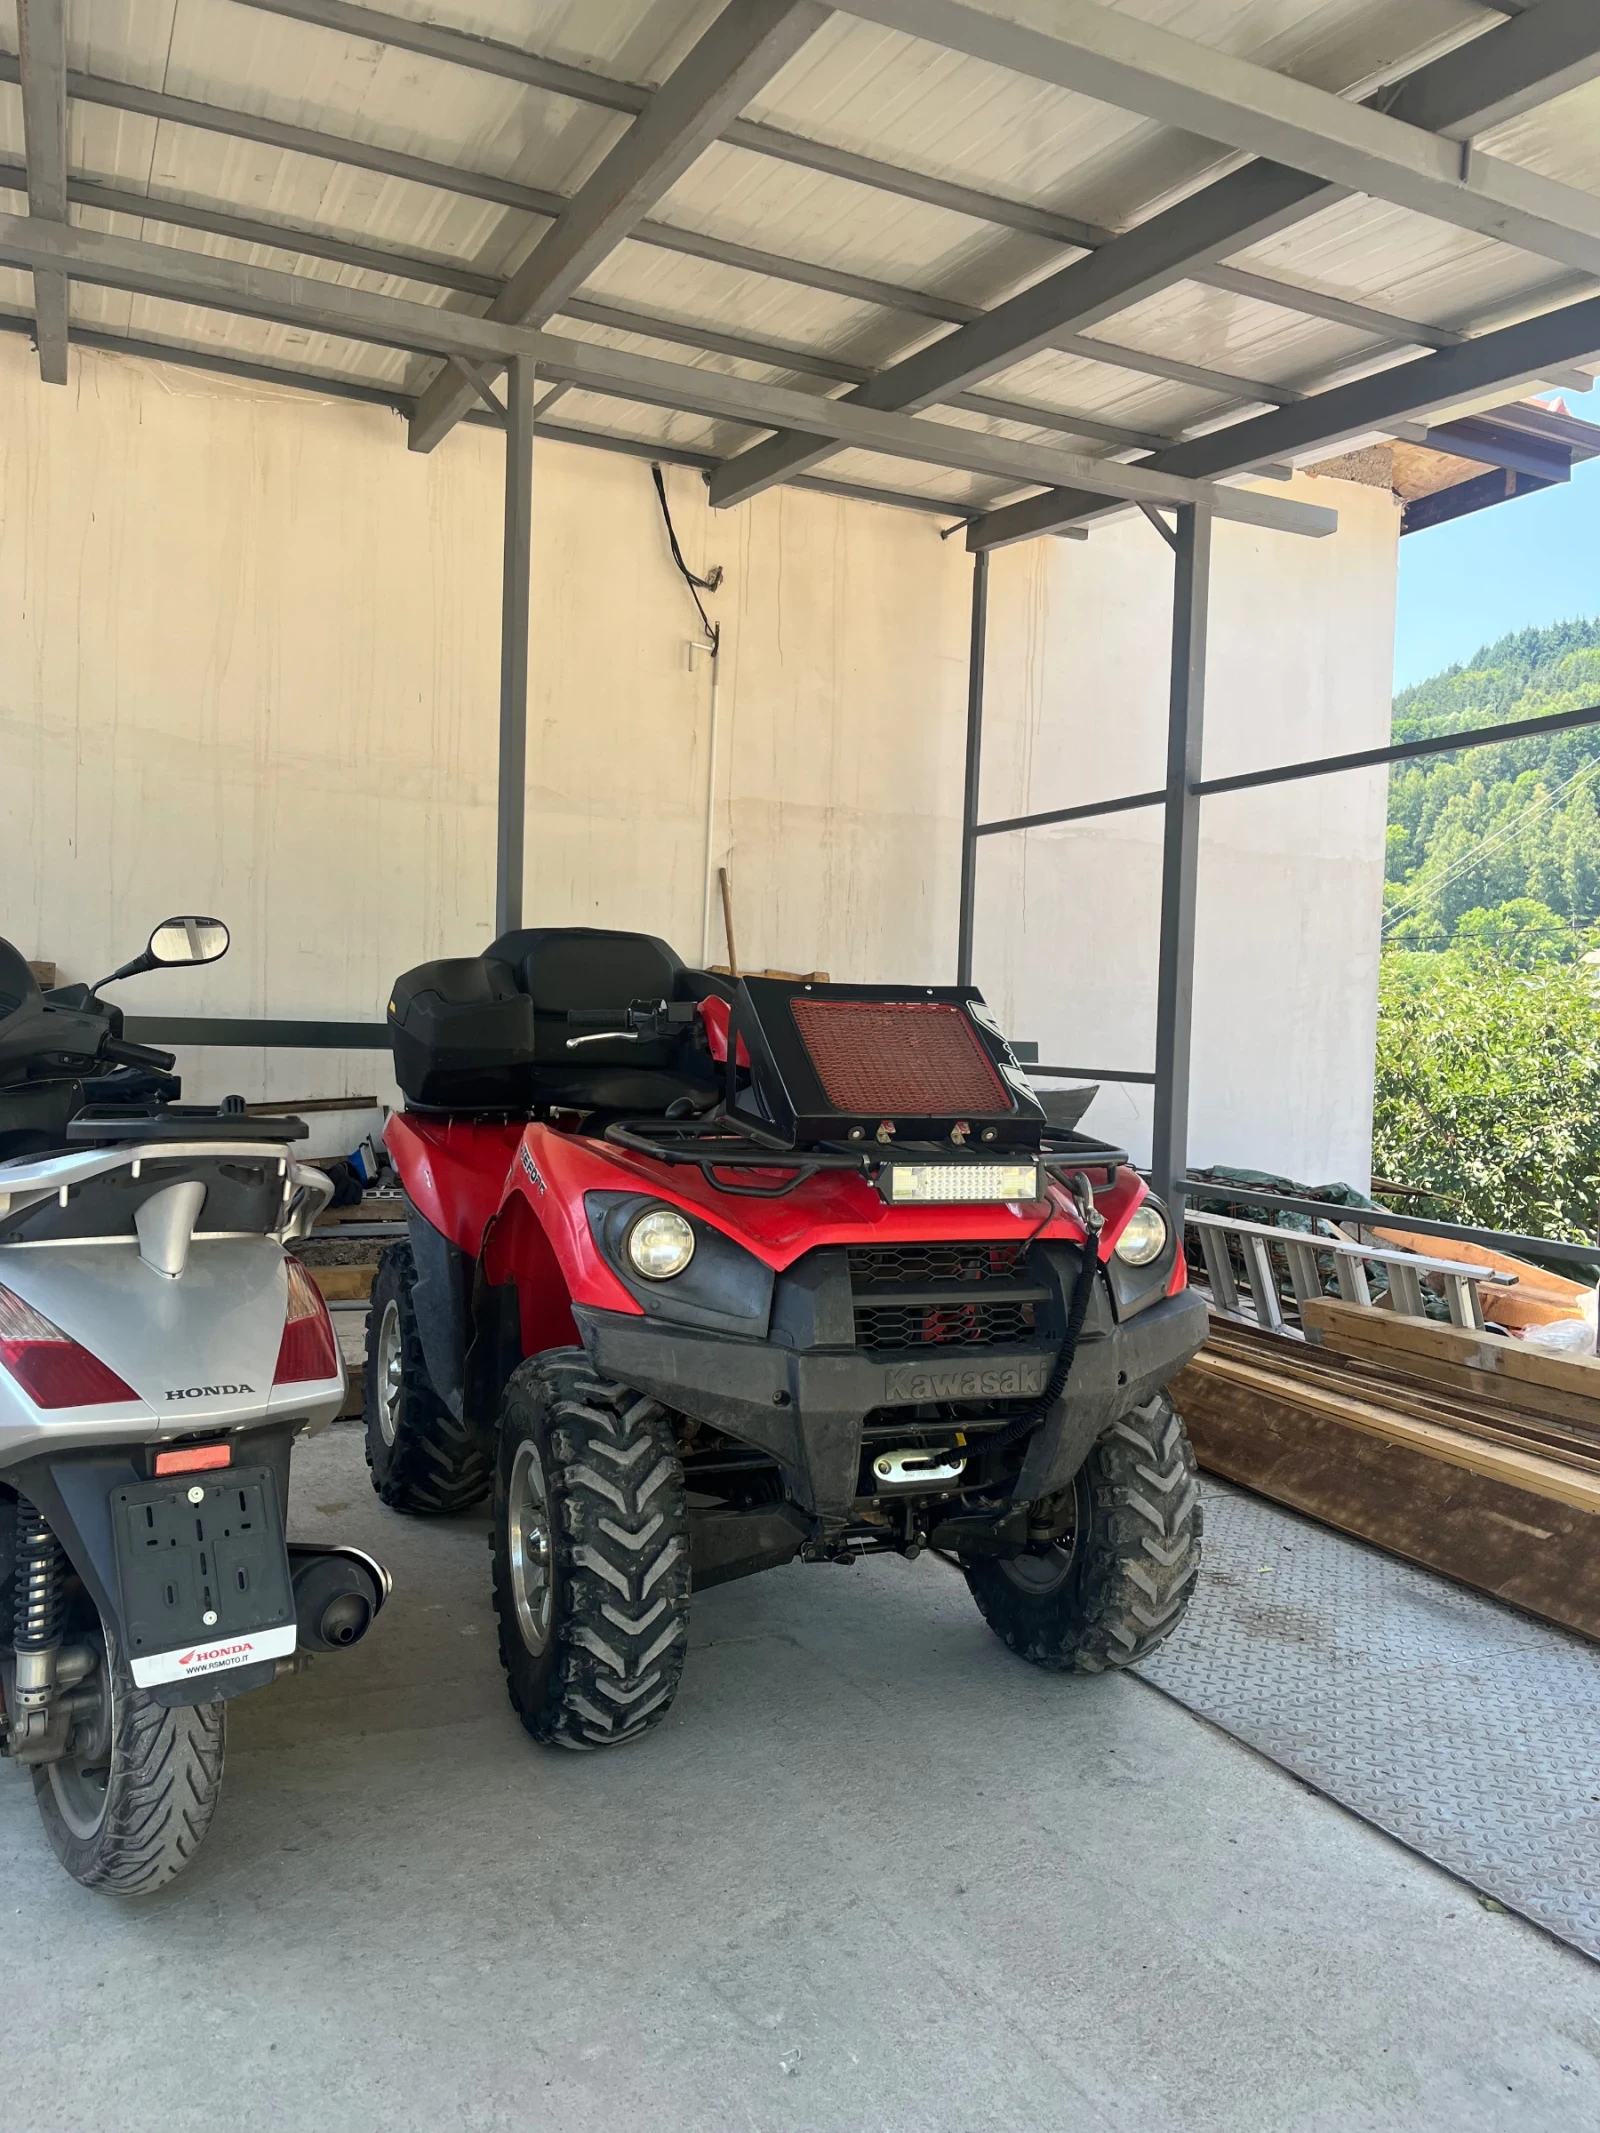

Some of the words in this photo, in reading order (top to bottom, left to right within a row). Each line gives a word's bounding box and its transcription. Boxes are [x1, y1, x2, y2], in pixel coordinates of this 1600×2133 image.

[884, 1361, 1048, 1400] Kawasaki
[165, 1384, 255, 1400] HONDA
[196, 1643, 254, 1662] HONDA
[186, 1655, 248, 1674] WWW.RSMOTO.IT
